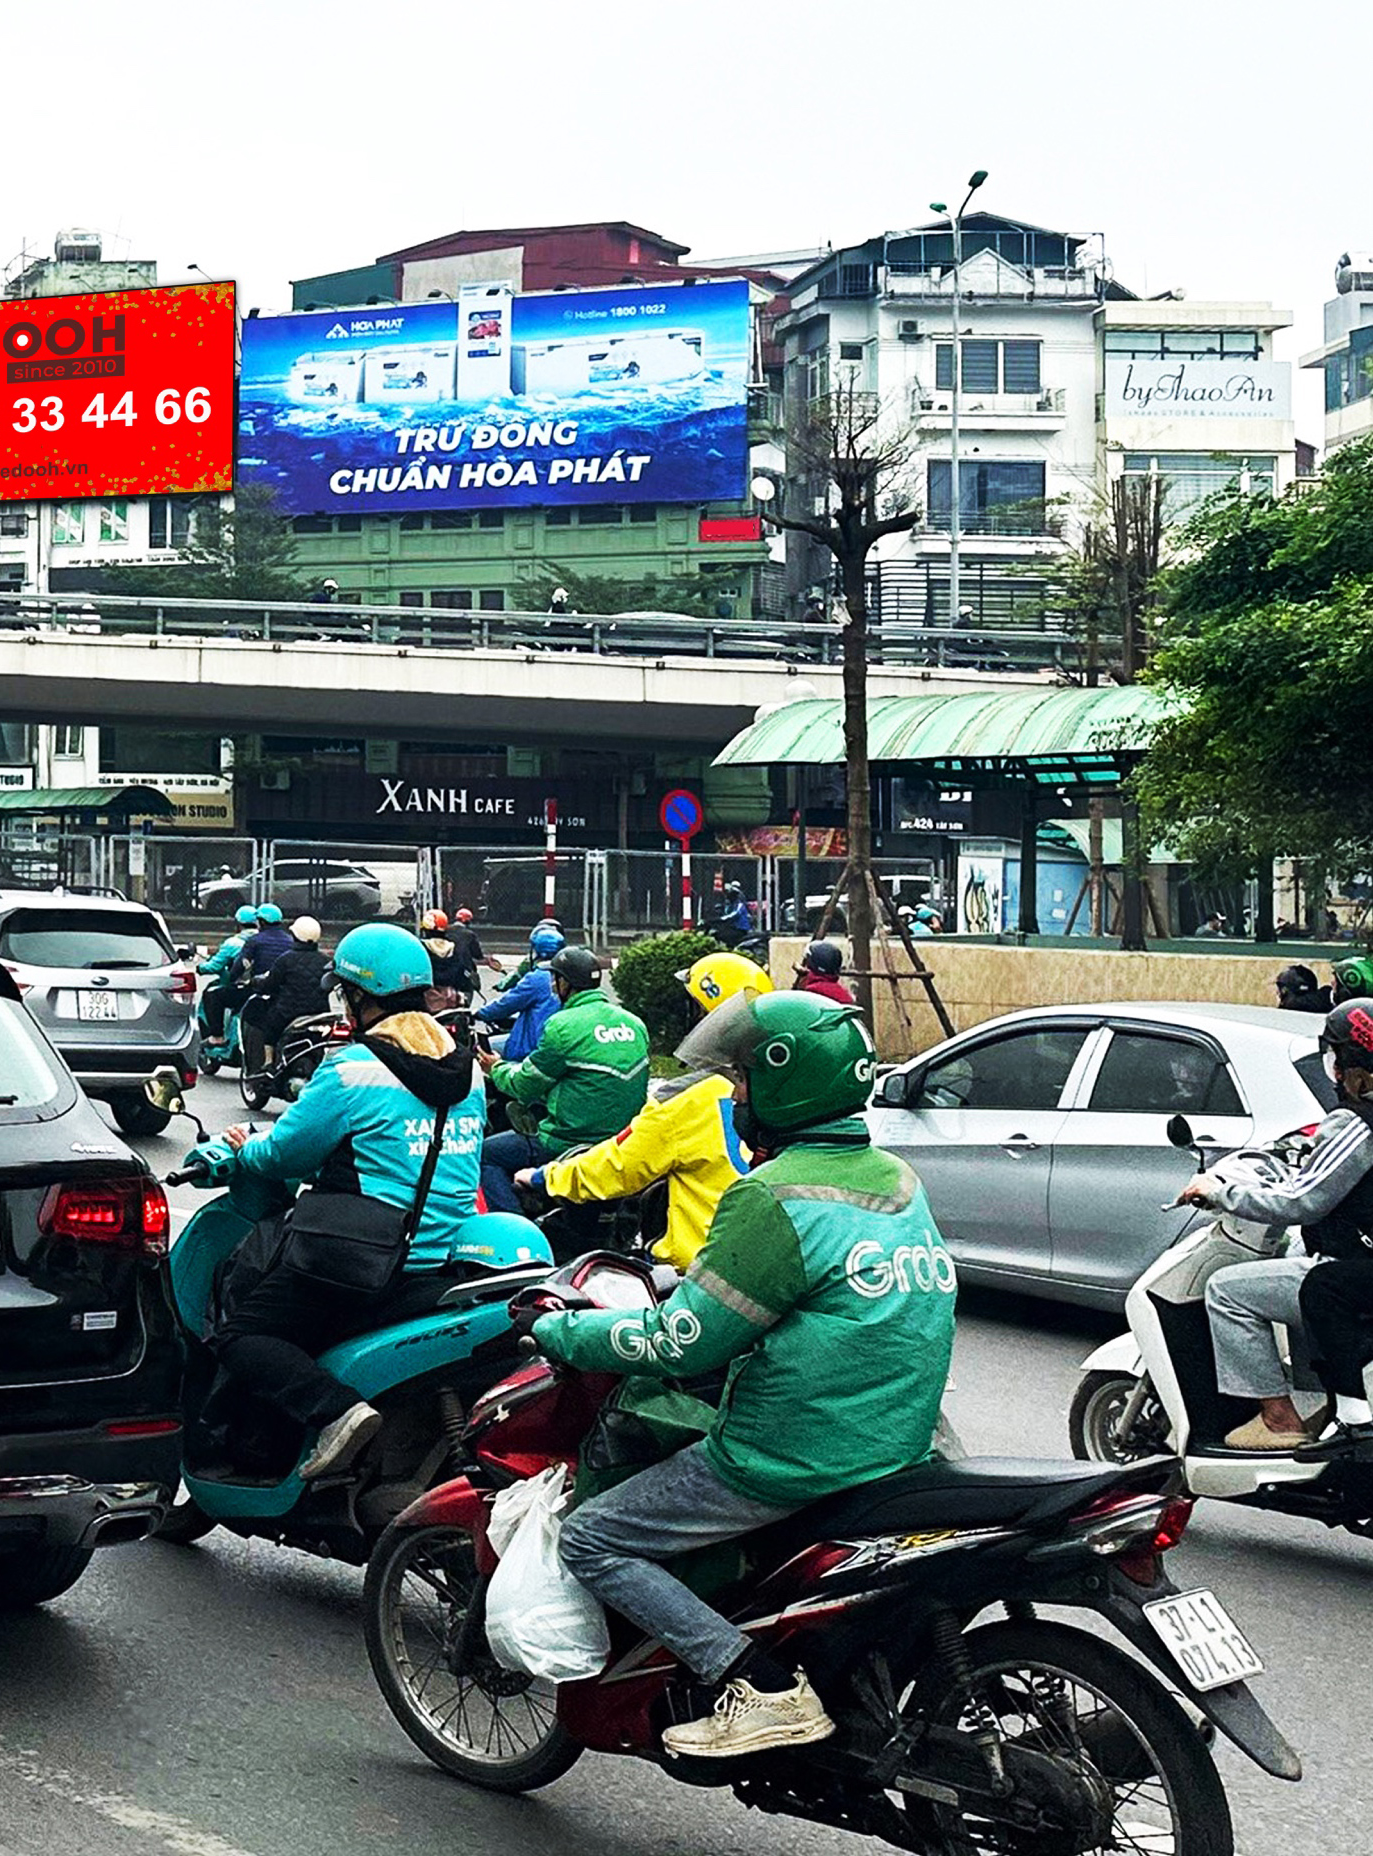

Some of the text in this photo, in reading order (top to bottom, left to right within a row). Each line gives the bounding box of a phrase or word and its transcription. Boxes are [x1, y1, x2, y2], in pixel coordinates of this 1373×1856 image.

[610, 305, 637, 317] 1800
[640, 303, 666, 315] 1022
[3, 314, 126, 359] OOH
[14, 359, 117, 381] since 2010
[11, 396, 65, 434] 33
[81, 391, 138, 429] 44
[154, 386, 212, 425] 66
[330, 449, 650, 495] CHUẨN HÒA PHÁT
[188, 804, 227, 818] STUDIO
[376, 778, 515, 814] XANH CAFE
[594, 1022, 635, 1043] Grab
[855, 1058, 877, 1082] Gr
[845, 1227, 957, 1298] Grab
